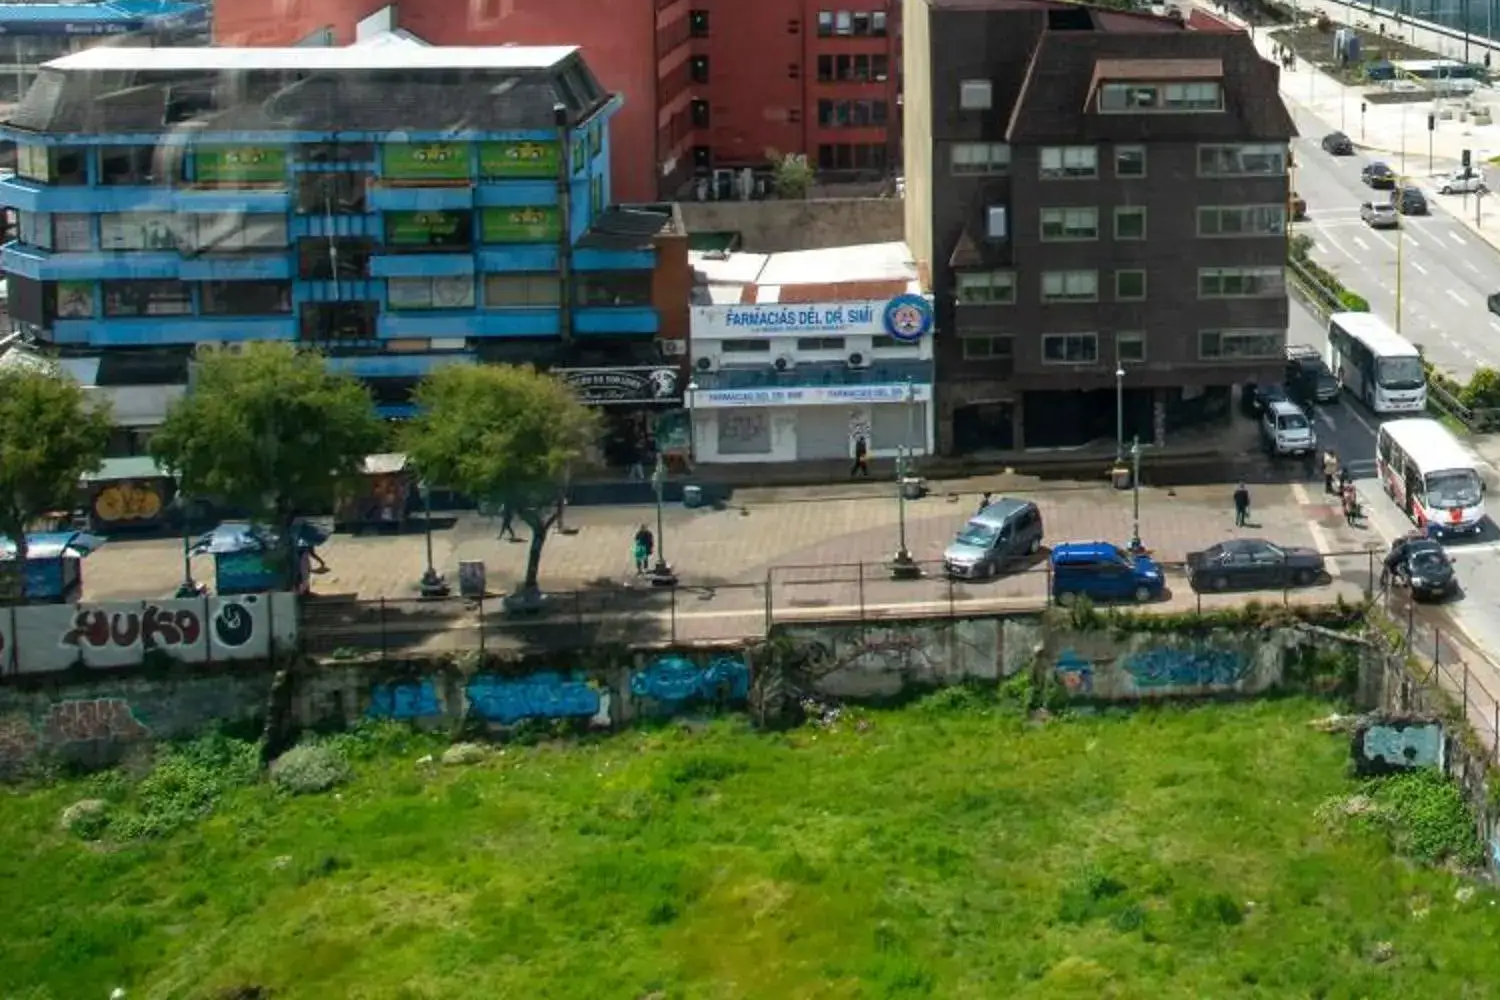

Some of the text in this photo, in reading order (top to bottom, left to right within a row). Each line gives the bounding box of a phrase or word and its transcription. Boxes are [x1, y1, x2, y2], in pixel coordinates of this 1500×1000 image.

[725, 311, 796, 326] FARMACIAS
[799, 311, 822, 324] DEL
[848, 309, 873, 323] SIMI
